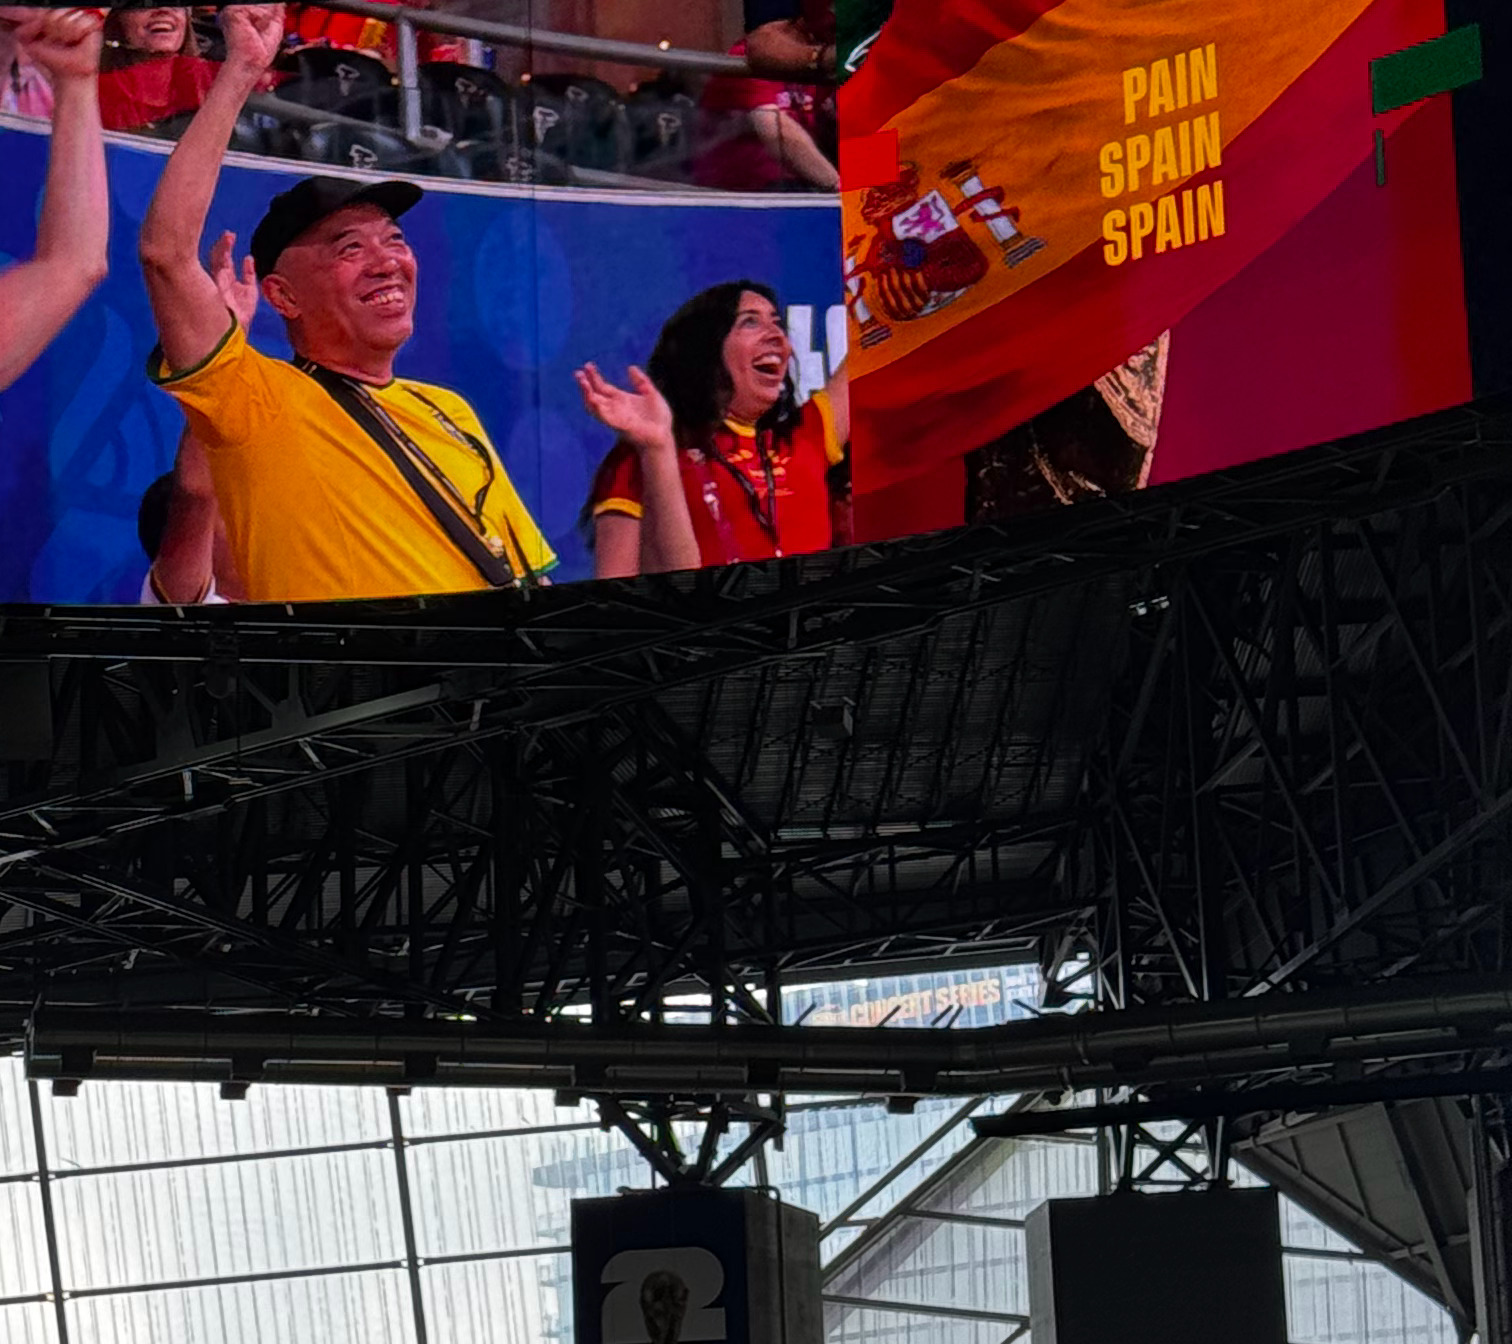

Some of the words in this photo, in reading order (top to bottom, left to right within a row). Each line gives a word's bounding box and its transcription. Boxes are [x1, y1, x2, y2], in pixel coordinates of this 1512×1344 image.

[1123, 43, 1218, 125] PAIN
[1100, 111, 1221, 198] SPAIN
[1102, 180, 1225, 266] SPAIN
